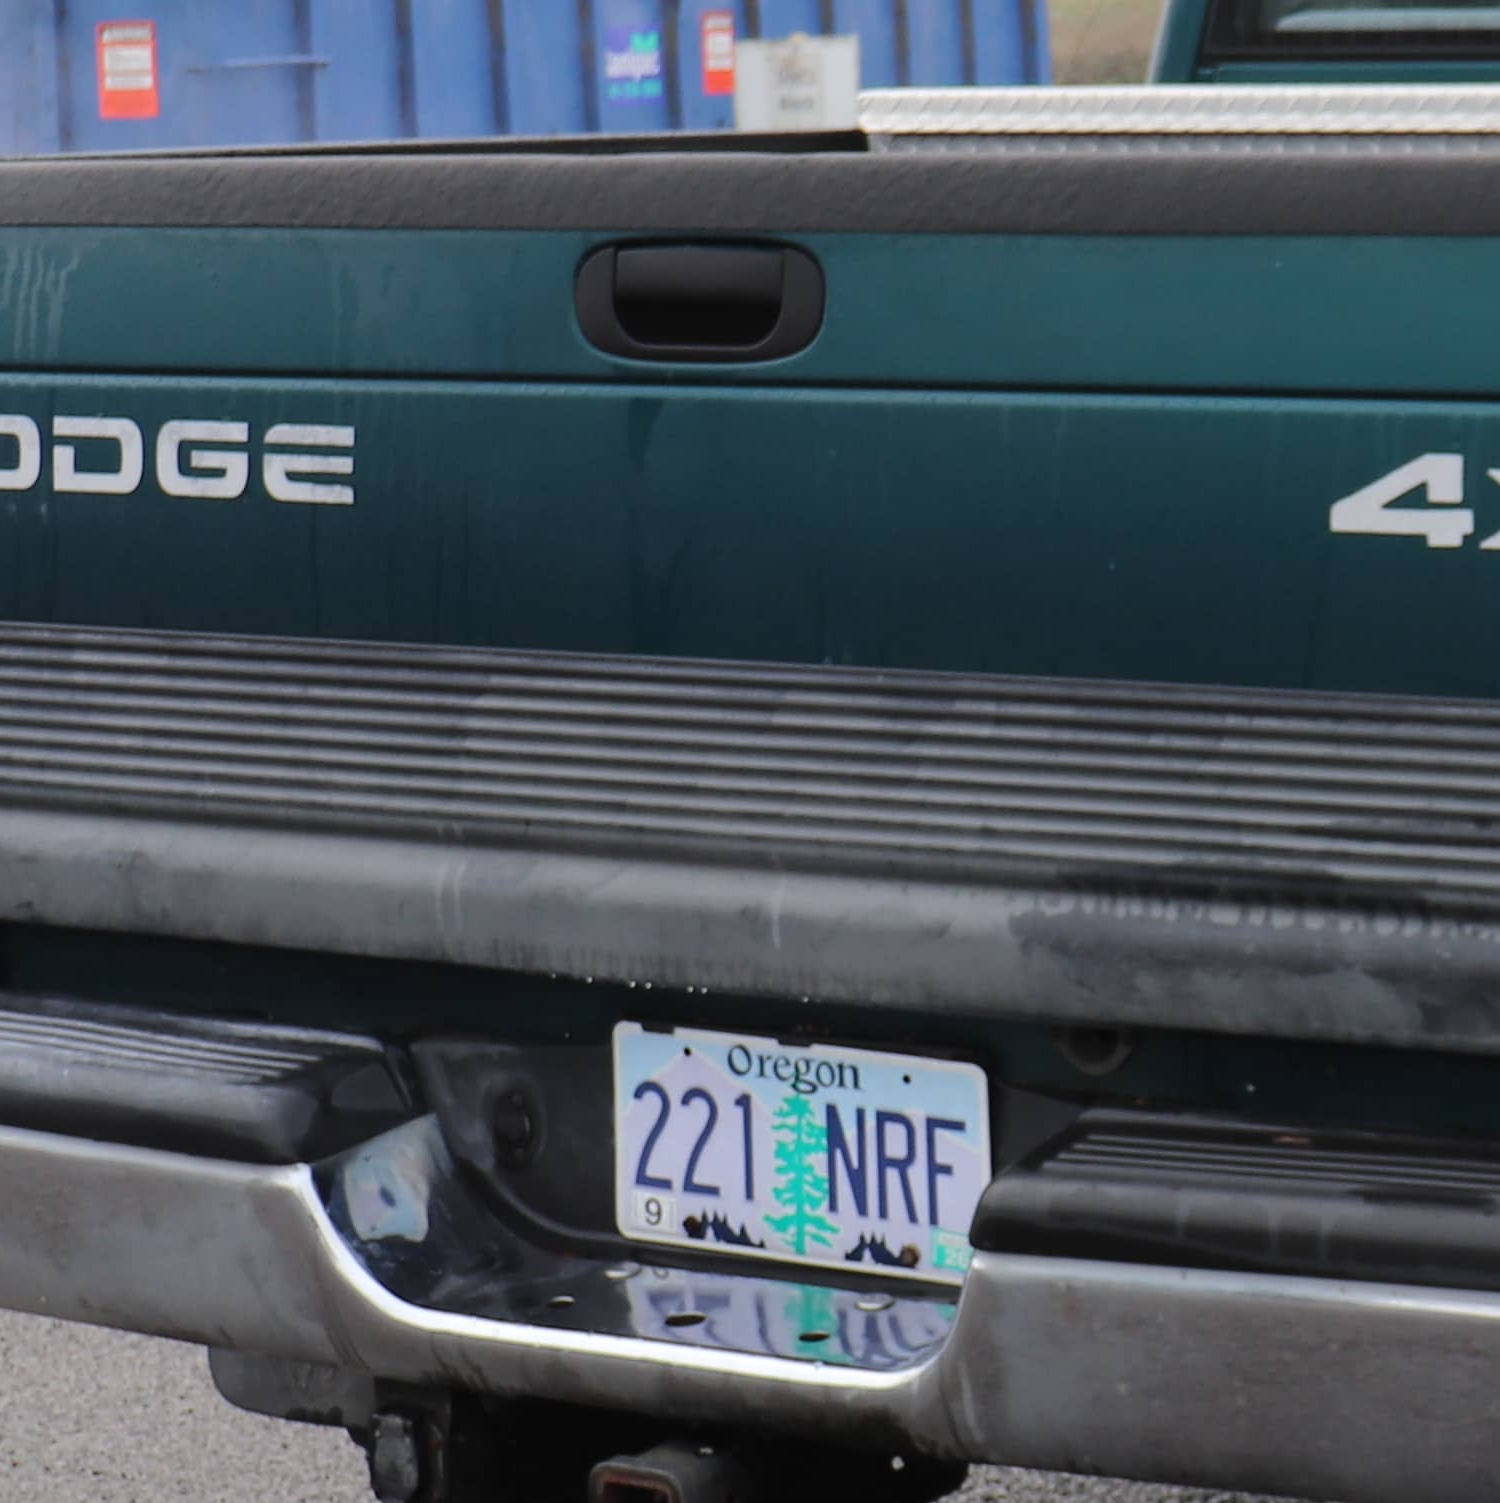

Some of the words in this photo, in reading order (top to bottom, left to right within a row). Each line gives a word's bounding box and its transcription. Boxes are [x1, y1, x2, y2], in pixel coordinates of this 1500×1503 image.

[726, 1044, 862, 1094] Oregon
[633, 1081, 755, 1202] 221
[825, 1103, 967, 1227] NRF
[643, 1198, 664, 1226] 9
